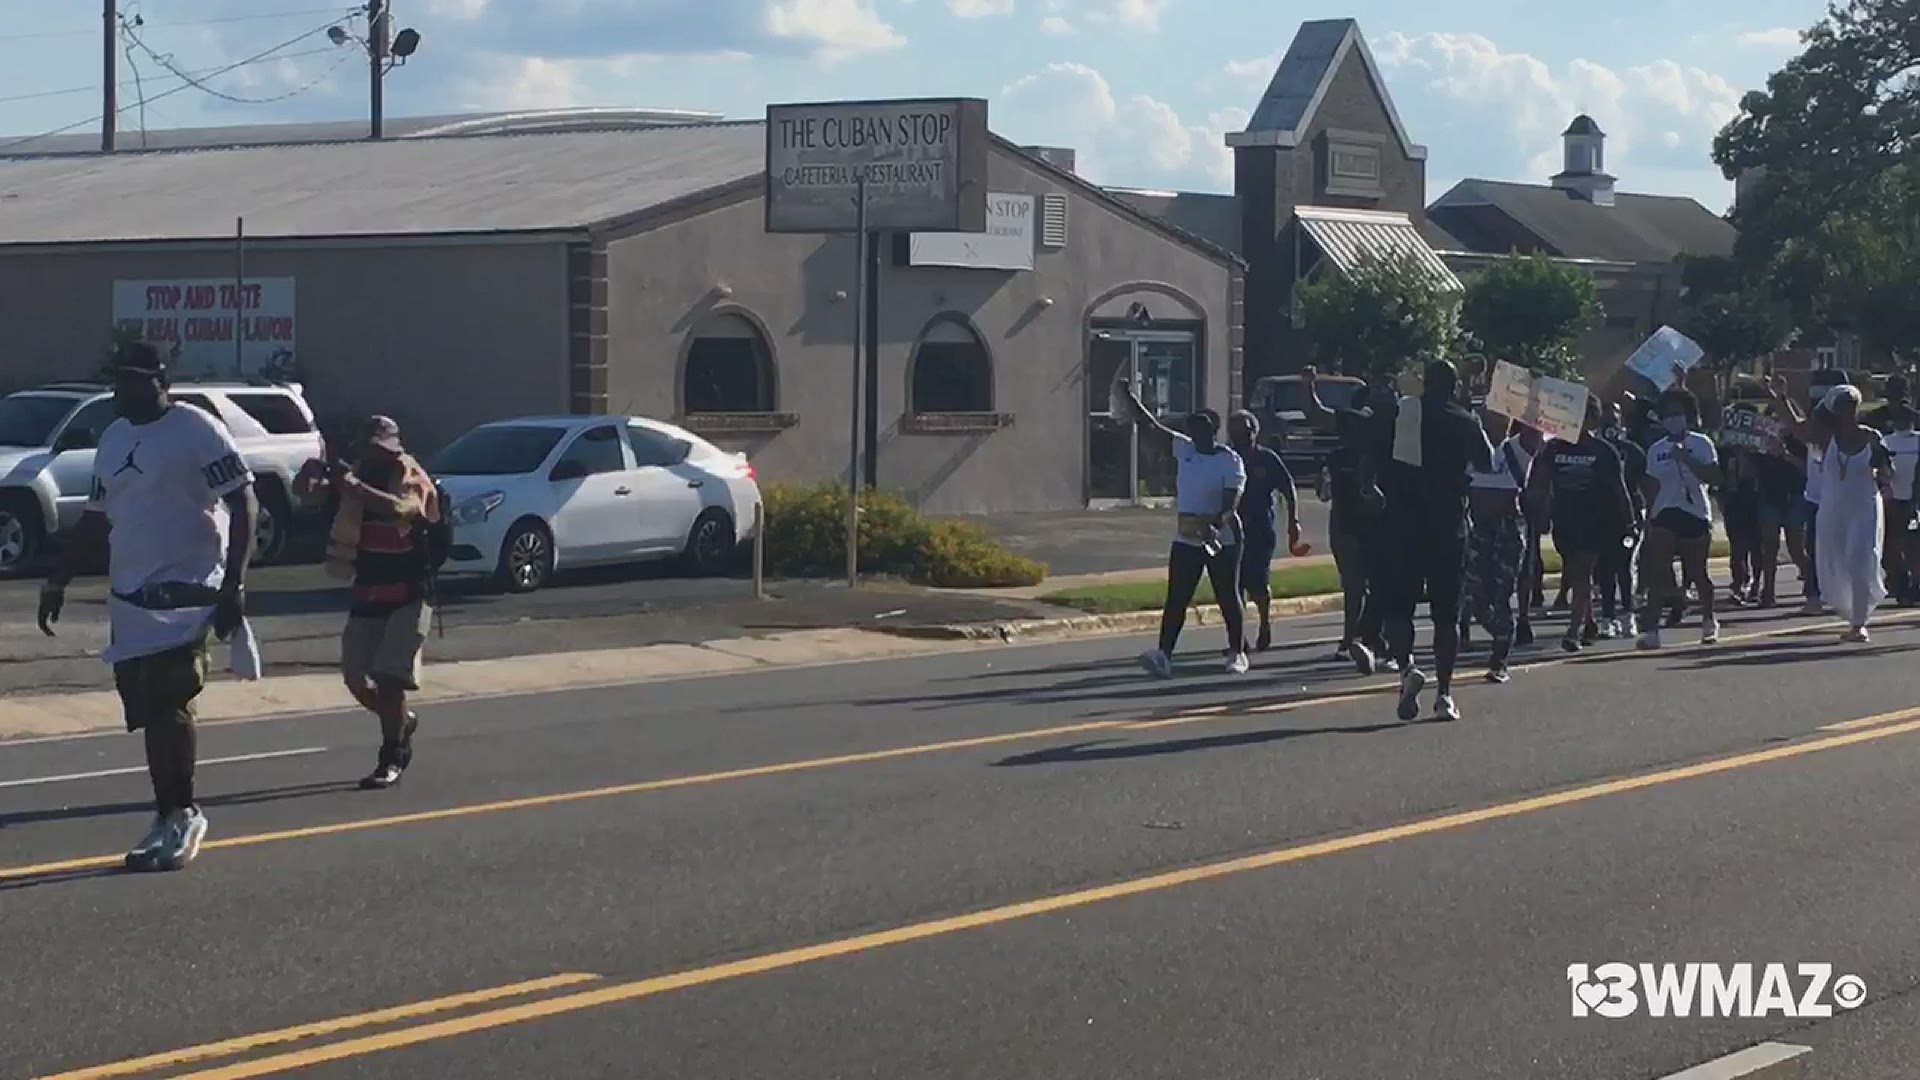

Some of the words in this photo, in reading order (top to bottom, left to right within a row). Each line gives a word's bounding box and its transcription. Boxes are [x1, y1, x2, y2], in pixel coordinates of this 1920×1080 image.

[779, 118, 816, 149] THE
[822, 117, 893, 147] CUBAN
[898, 114, 950, 146] STOP
[784, 165, 848, 185] CAFETERIA
[864, 162, 942, 184] RESTAURANT
[996, 201, 1030, 218] STOP
[146, 286, 181, 310] STOP
[184, 285, 215, 309] AND
[185, 318, 233, 341] CUBAN
[240, 316, 293, 341] LAVOR
